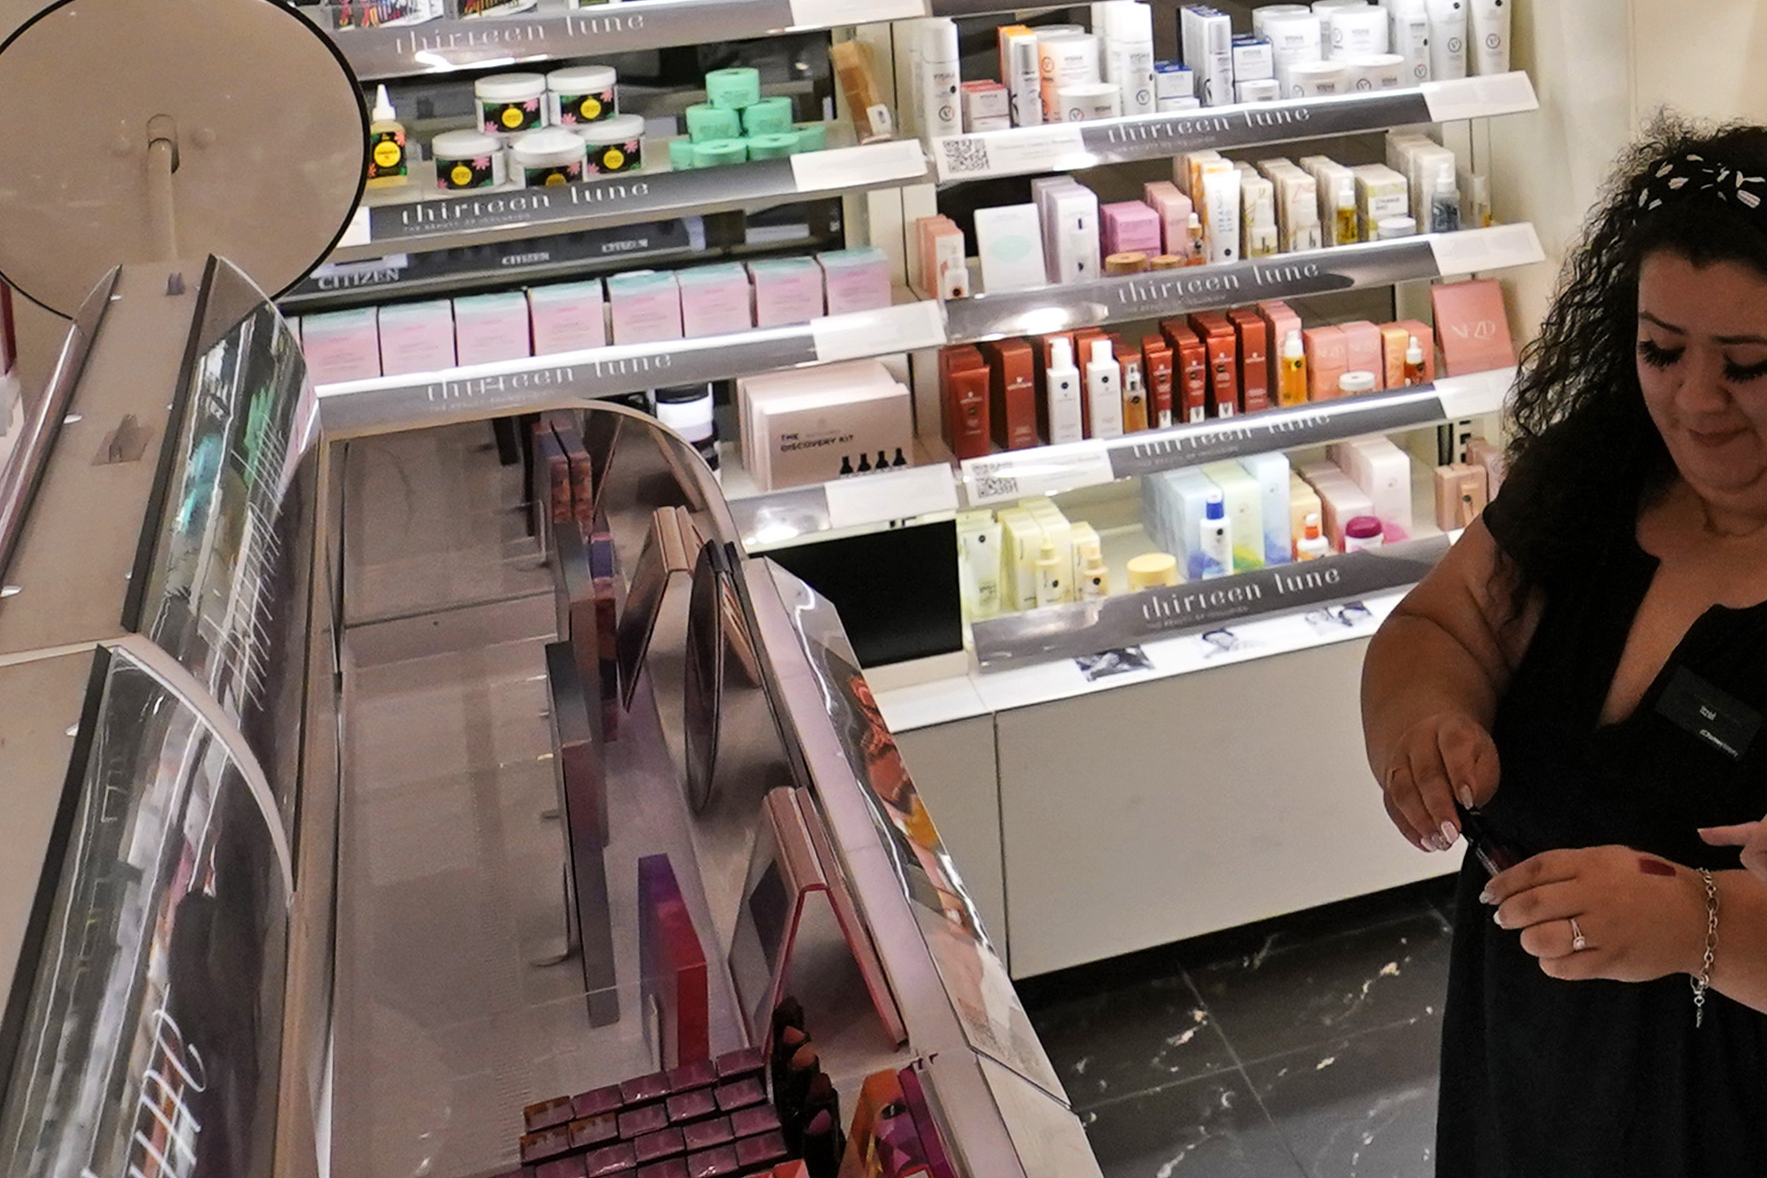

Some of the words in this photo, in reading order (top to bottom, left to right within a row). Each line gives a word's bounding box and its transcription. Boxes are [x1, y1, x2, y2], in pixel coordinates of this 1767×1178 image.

[396, 21, 545, 54] thirteen
[565, 13, 645, 36] lune
[1108, 118, 1230, 144] thirteen
[1244, 107, 1310, 129] lune
[402, 193, 549, 225] thirteen
[571, 182, 649, 204] lune
[502, 252, 550, 266] CITIZEN
[318, 269, 400, 290] CITIZEN
[1119, 273, 1239, 303] thirteen
[1254, 263, 1319, 287] lune
[1142, 582, 1262, 621] thirteen
[1274, 568, 1340, 595] lune
